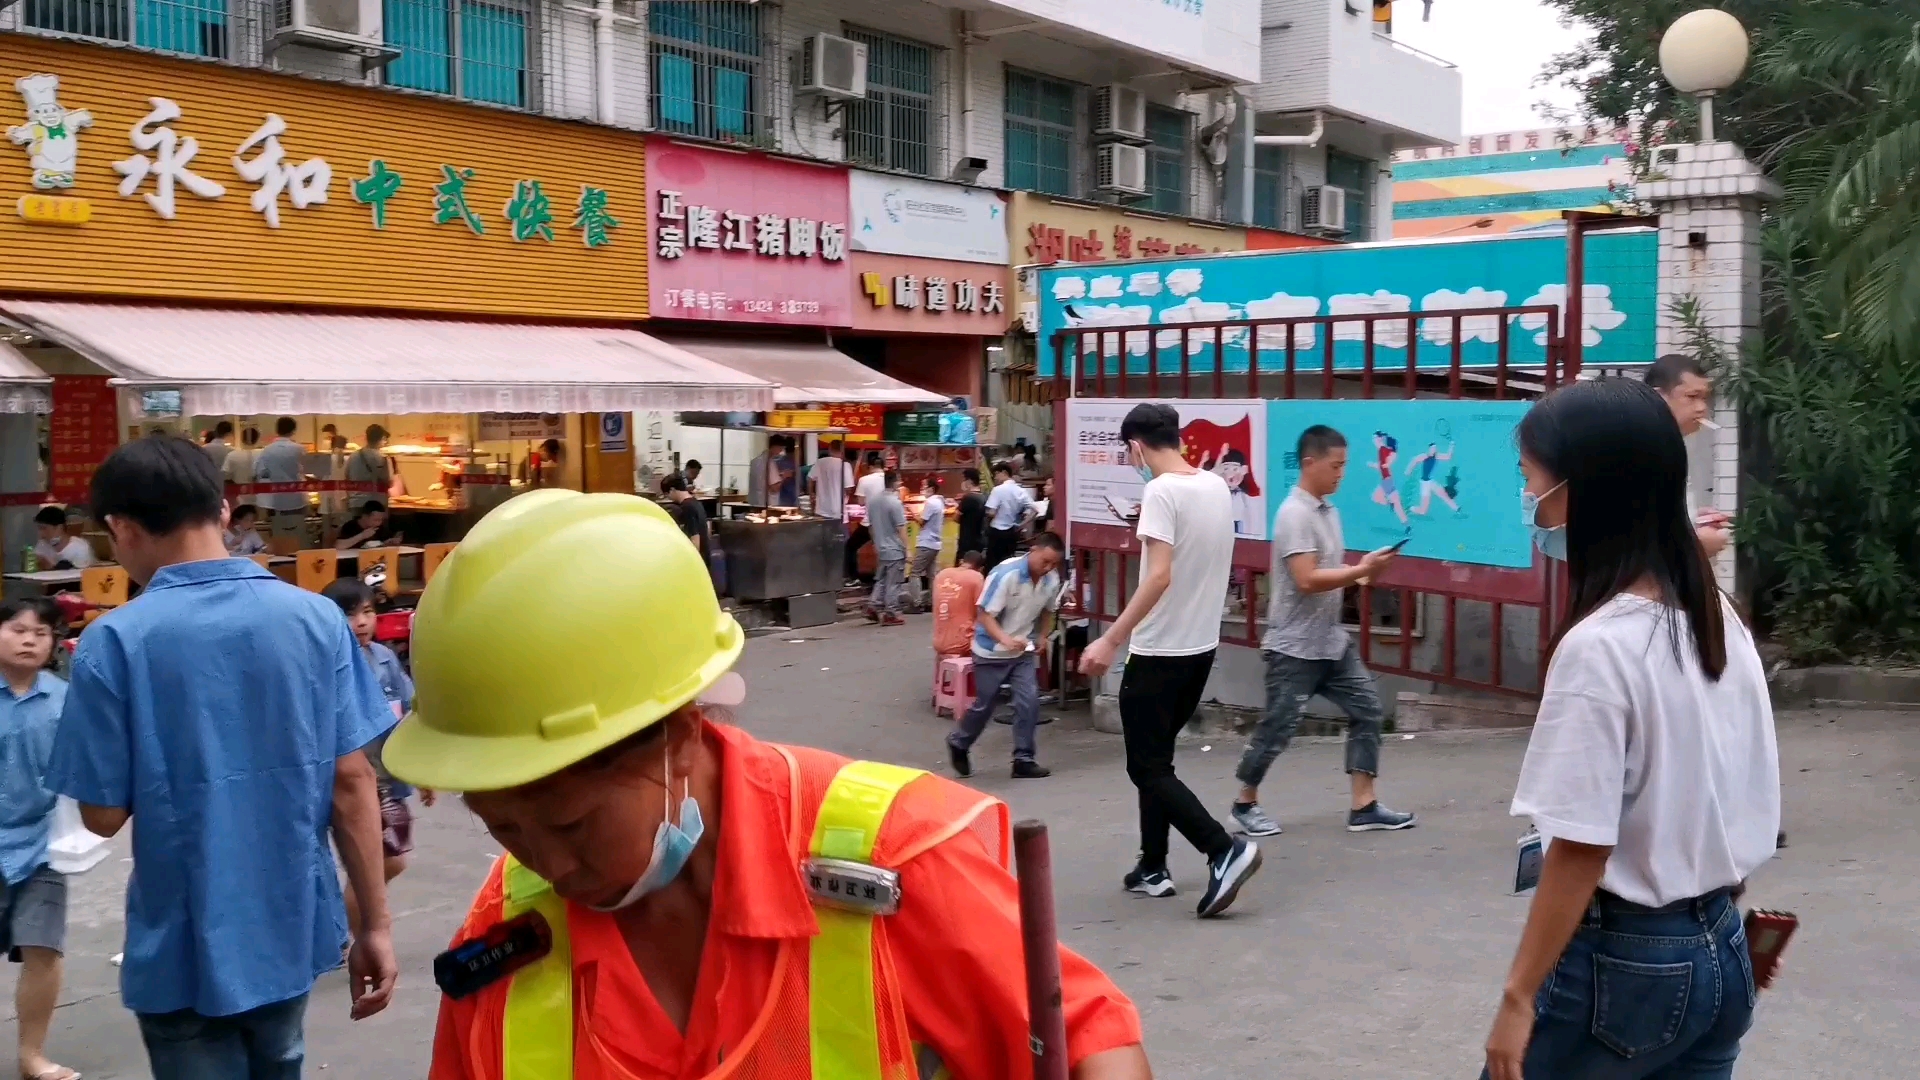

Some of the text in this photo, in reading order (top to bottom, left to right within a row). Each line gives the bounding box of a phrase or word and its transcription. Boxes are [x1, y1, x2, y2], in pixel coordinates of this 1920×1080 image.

[112, 97, 619, 247] 永和 中式快餐
[657, 189, 685, 258] 正宗
[687, 205, 846, 261] 隆江猪脚饭
[894, 274, 1005, 313] 味道功夫
